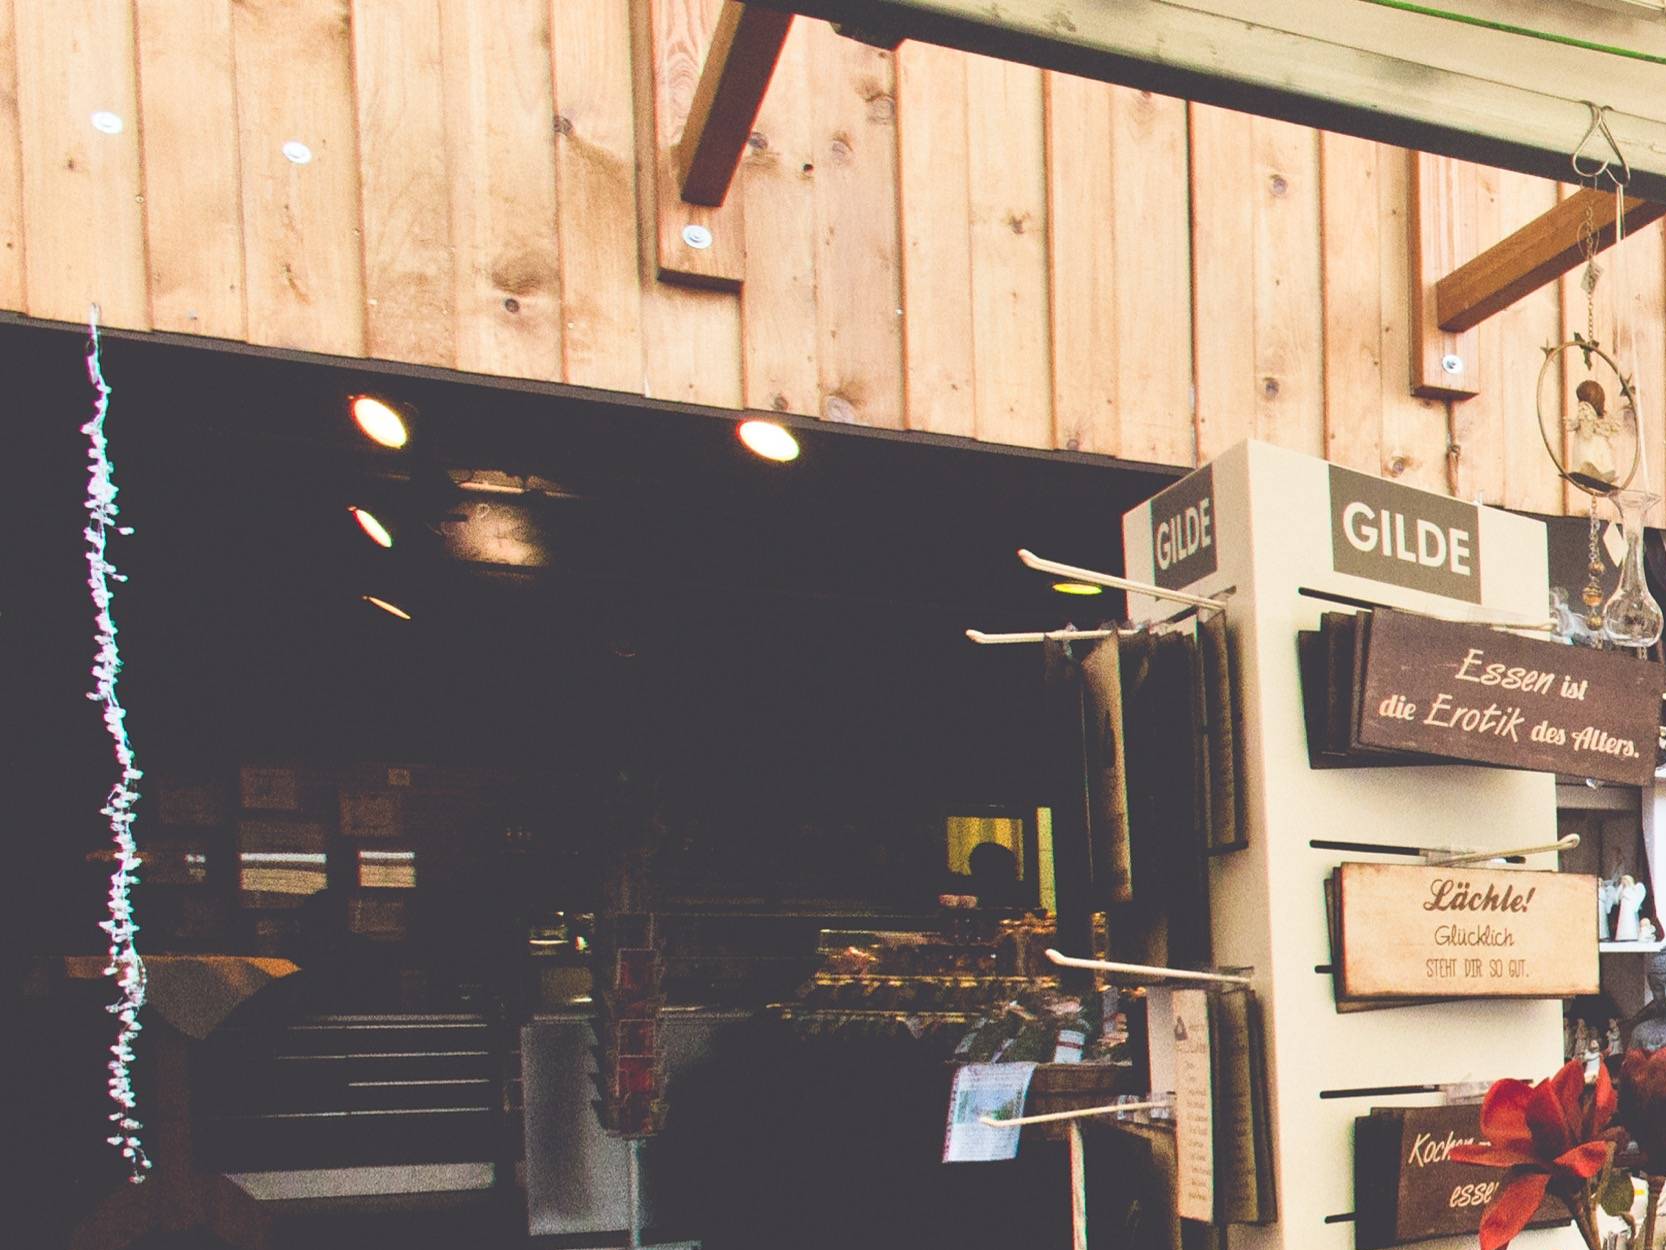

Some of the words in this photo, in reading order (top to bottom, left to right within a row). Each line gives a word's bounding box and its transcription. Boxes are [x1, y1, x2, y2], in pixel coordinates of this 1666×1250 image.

[1156, 498, 1211, 571] GILDE
[1342, 502, 1471, 576] GILDE
[1455, 649, 1555, 695] Essen
[1561, 675, 1588, 700] ist
[1379, 695, 1417, 721] die
[1424, 693, 1525, 743] Erotik
[1531, 721, 1566, 746] des
[1572, 726, 1640, 758] Alters.
[1423, 879, 1536, 913] Lächle!
[1434, 924, 1515, 947] Glücklich
[1426, 958, 1458, 978] STEHT
[1464, 958, 1483, 978] DIR
[1489, 958, 1503, 978] SO
[1508, 958, 1530, 978] GUT.
[1449, 1181, 1500, 1208] esse
